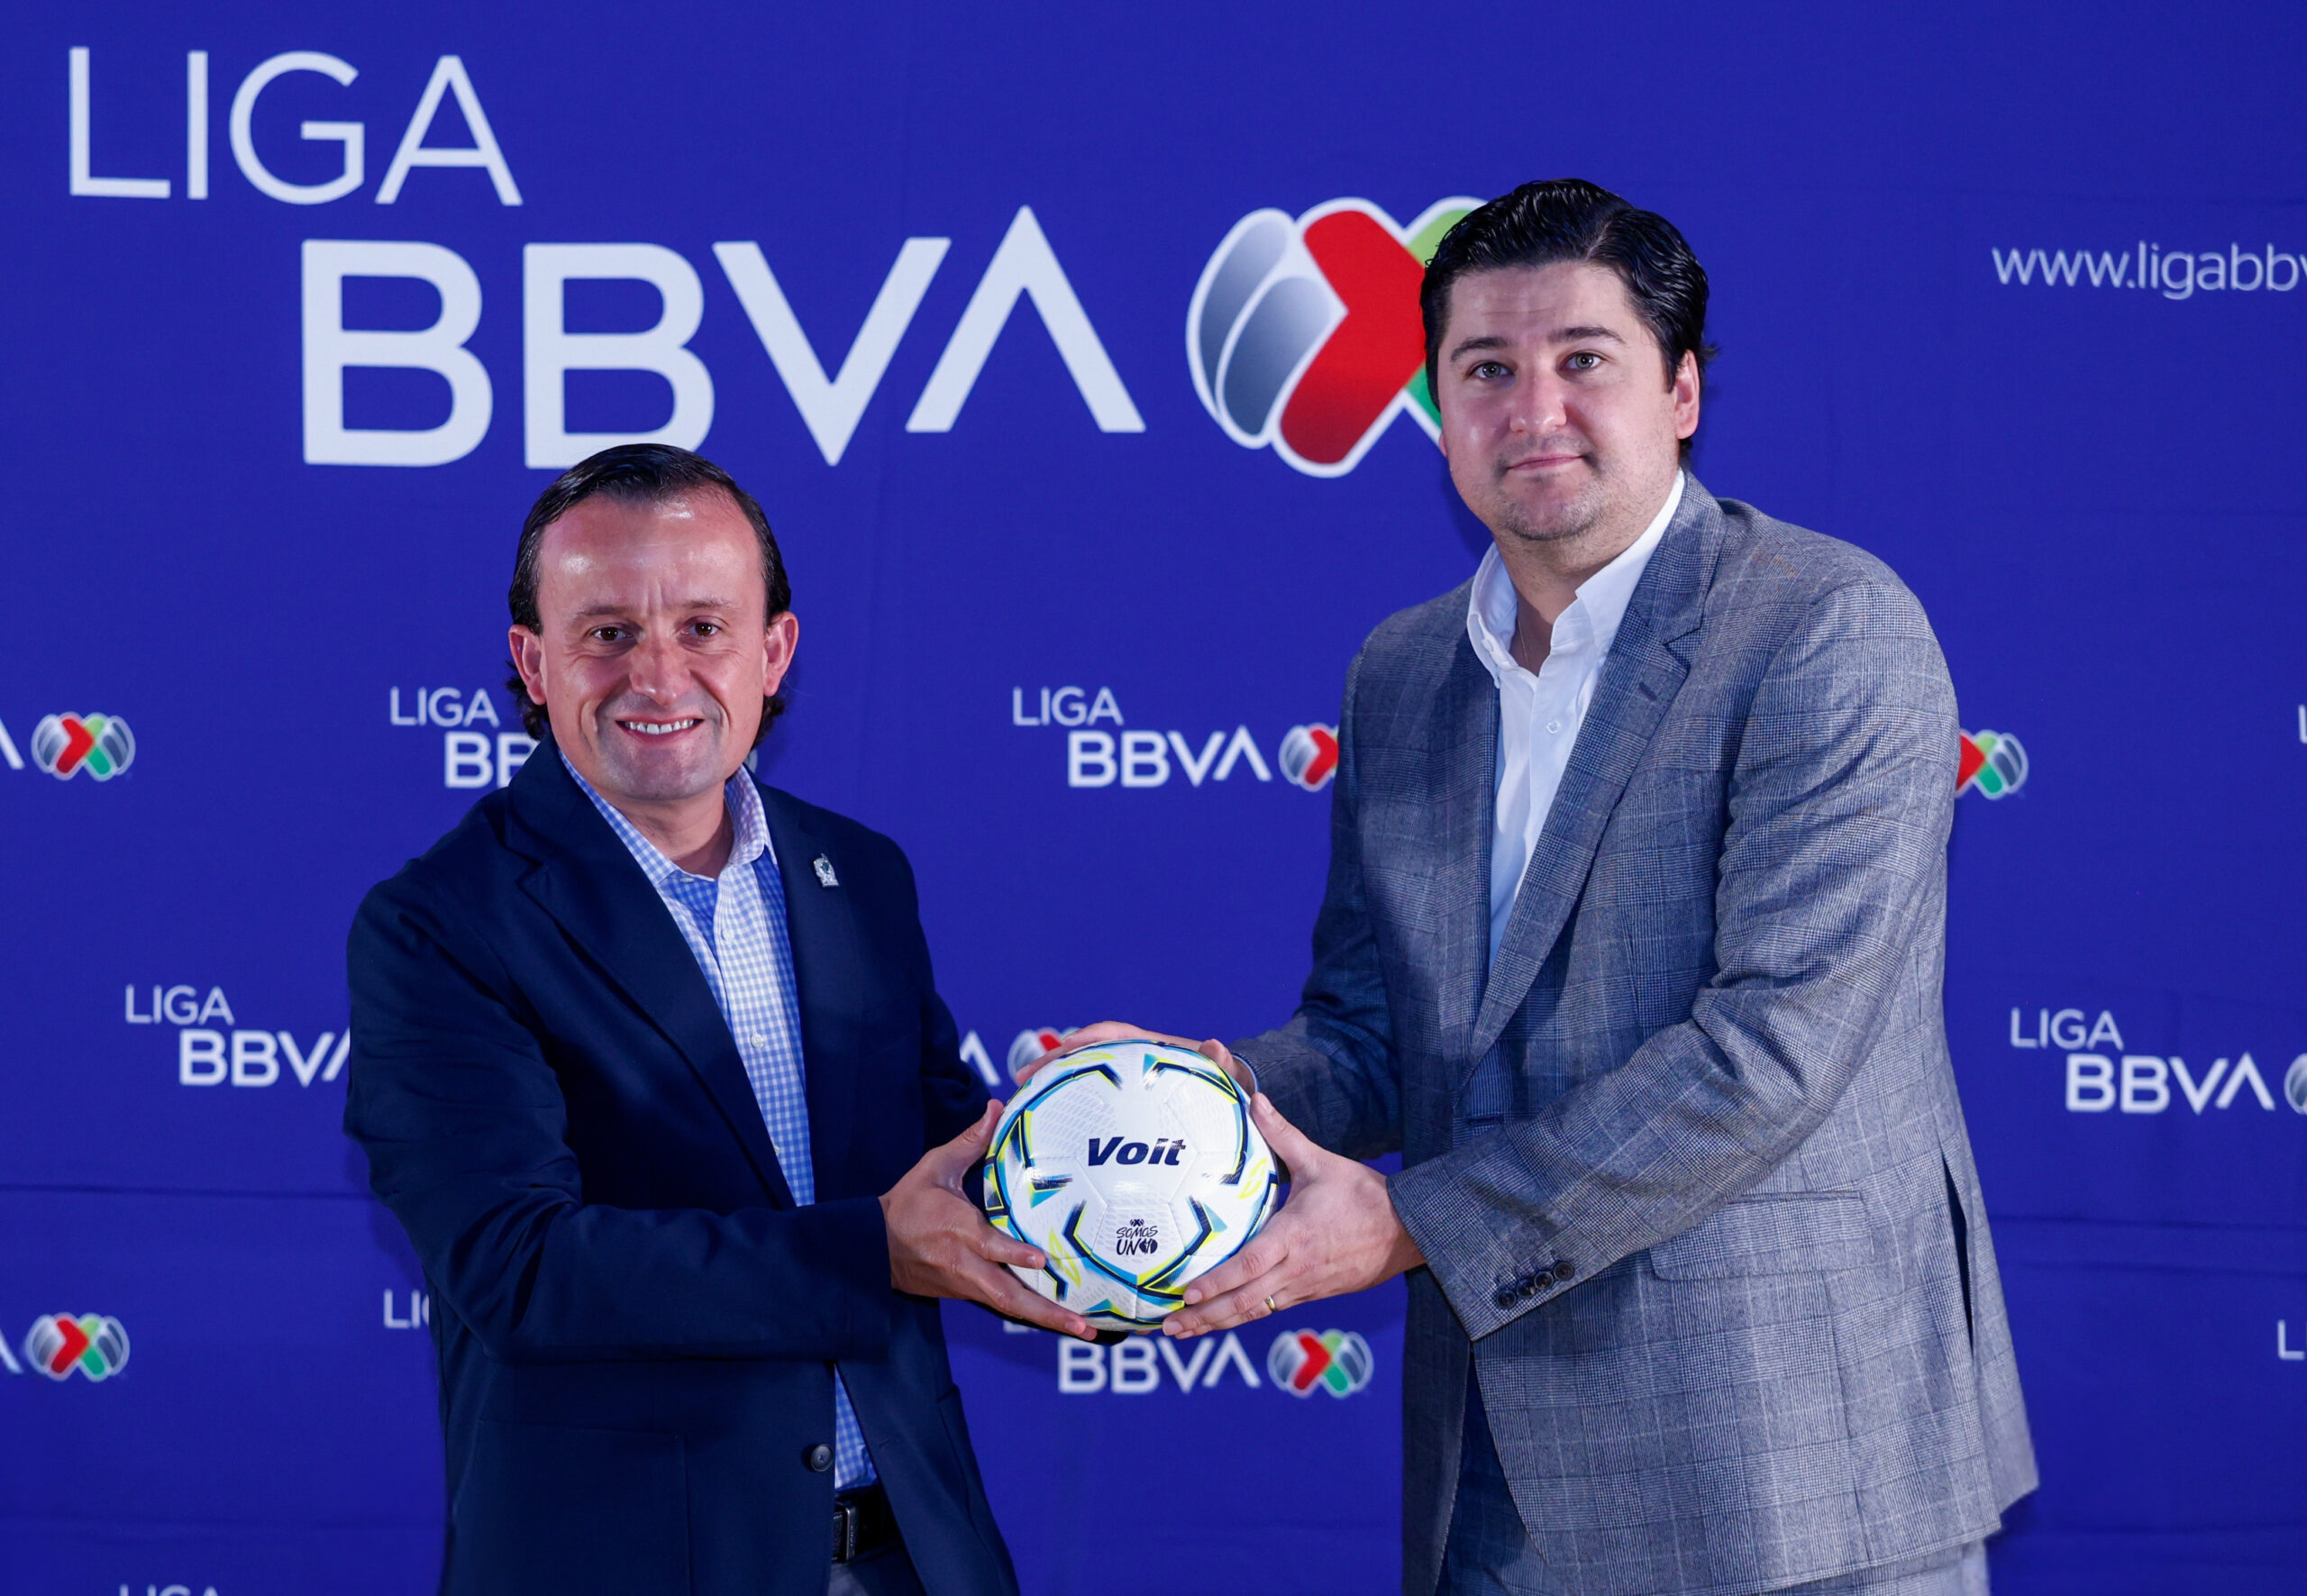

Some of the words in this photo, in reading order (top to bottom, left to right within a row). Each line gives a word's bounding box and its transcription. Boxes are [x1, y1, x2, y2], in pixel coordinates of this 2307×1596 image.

[68, 46, 524, 206] LIGA
[301, 204, 1147, 468] BBVA
[390, 686, 500, 727] LIGA
[1012, 686, 1125, 725] LIGA
[444, 731, 541, 789] BB
[1068, 725, 1272, 788] BBVA
[125, 984, 235, 1026] LIGA
[2011, 1008, 2124, 1051] LIGA
[2065, 1052, 2276, 1115] BBVA
[1088, 1136, 1186, 1166] Voit
[1058, 1331, 1261, 1394] BBVA
